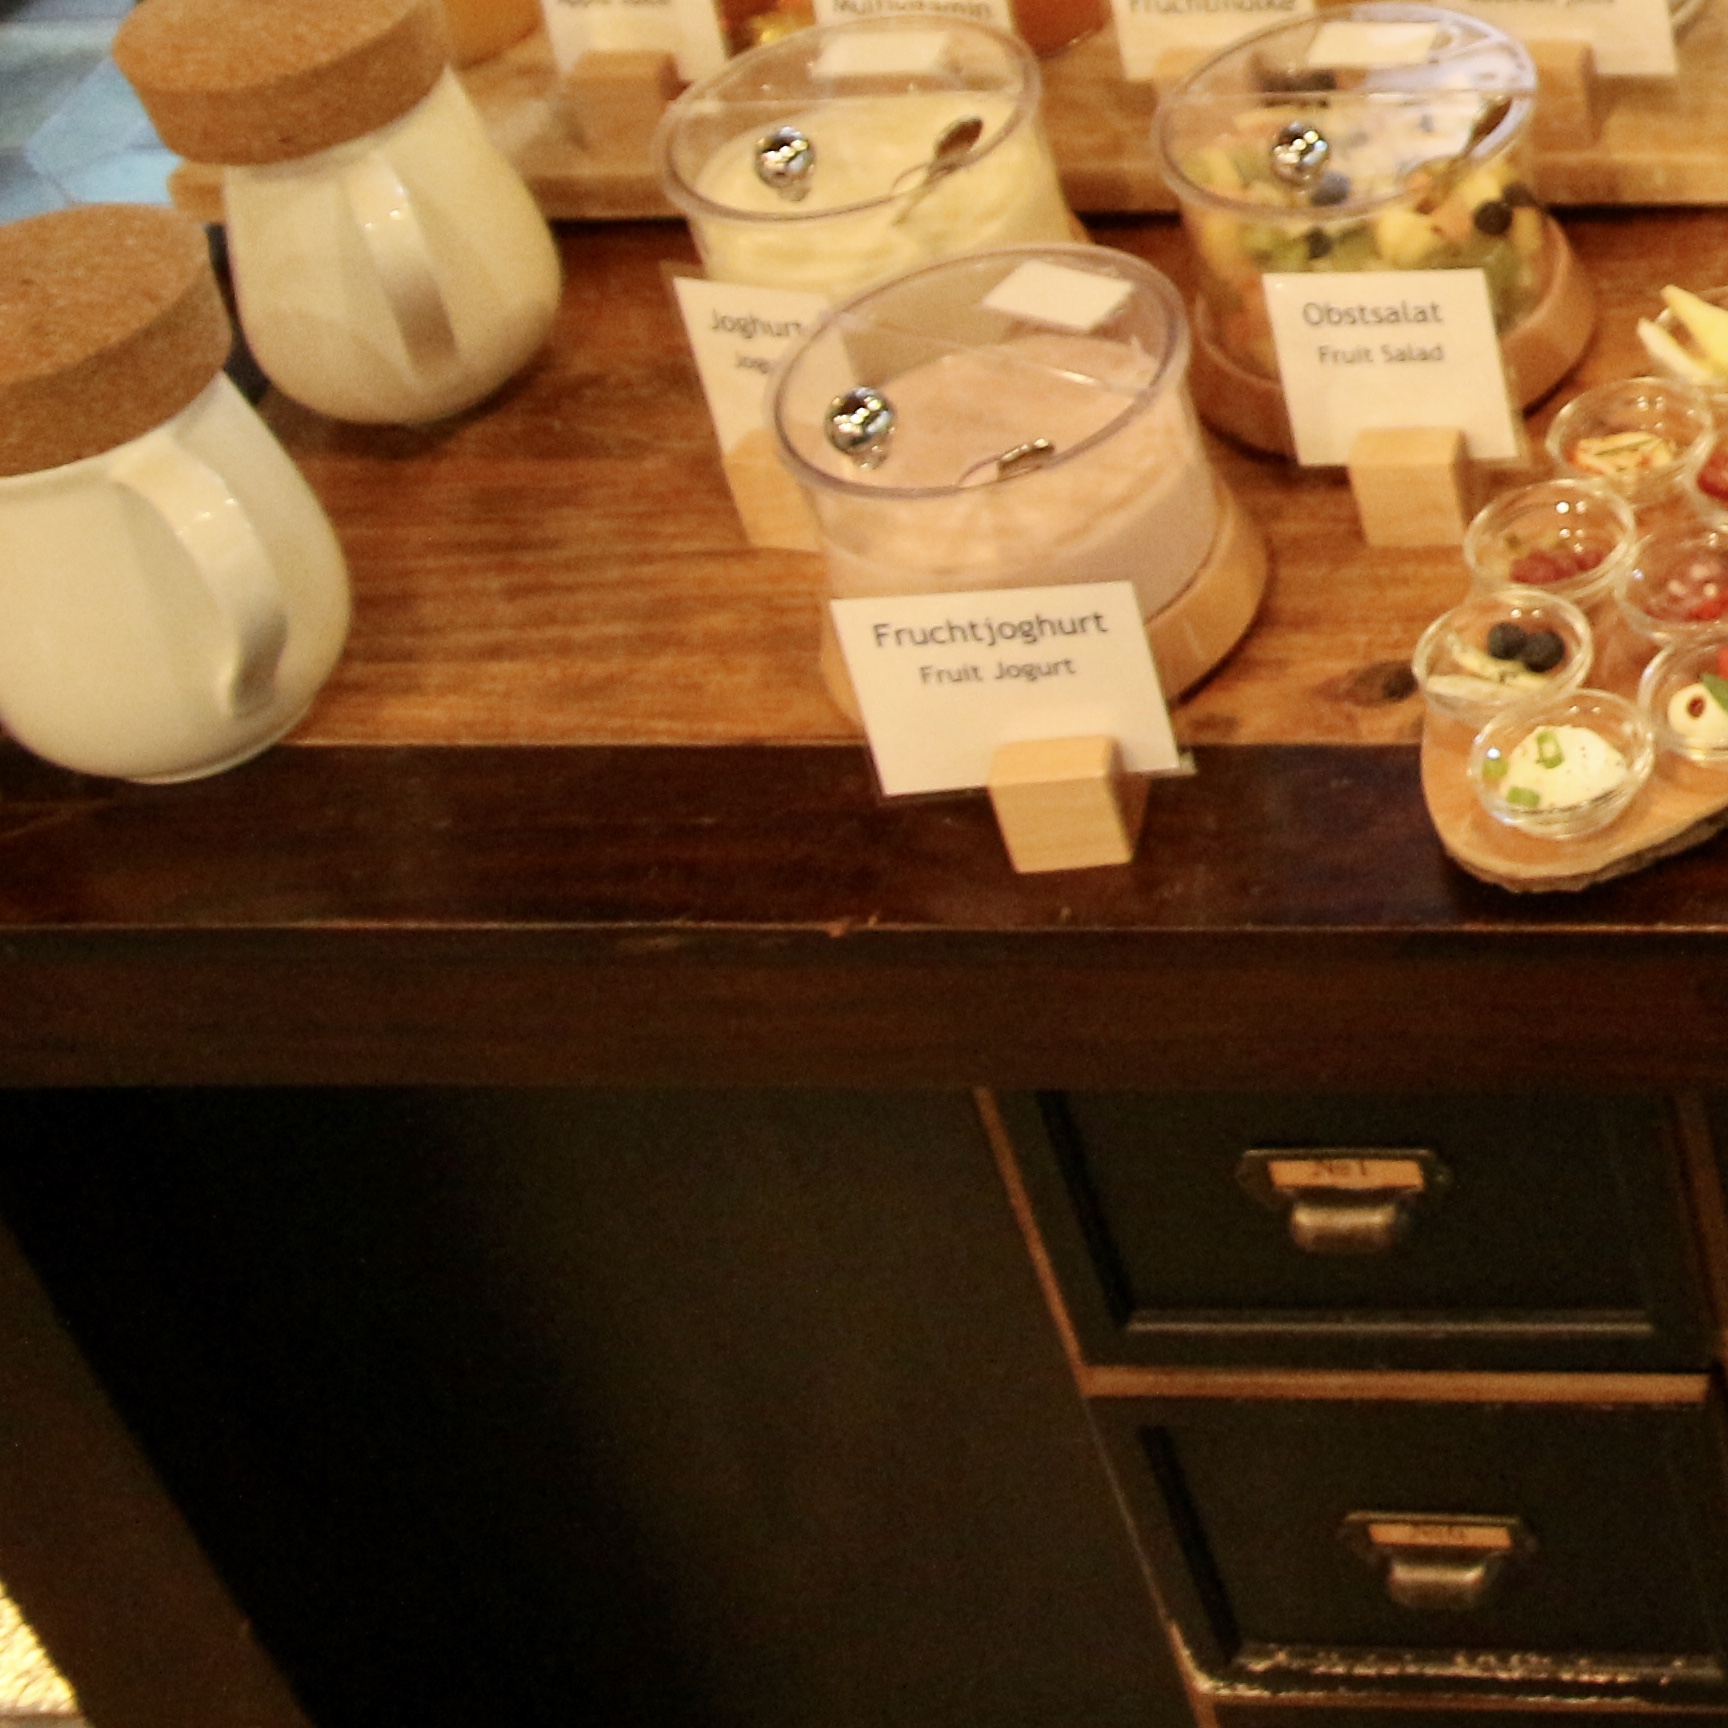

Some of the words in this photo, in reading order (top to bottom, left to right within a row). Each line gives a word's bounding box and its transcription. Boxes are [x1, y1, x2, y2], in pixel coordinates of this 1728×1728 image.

[1303, 300, 1444, 325] Obstsalat
[1319, 345, 1373, 364] Fruit
[1380, 343, 1444, 362] Salad
[872, 611, 1109, 647] Fruchtjoghurt
[919, 663, 984, 685] Fruit
[994, 657, 1077, 682] Jogurt
